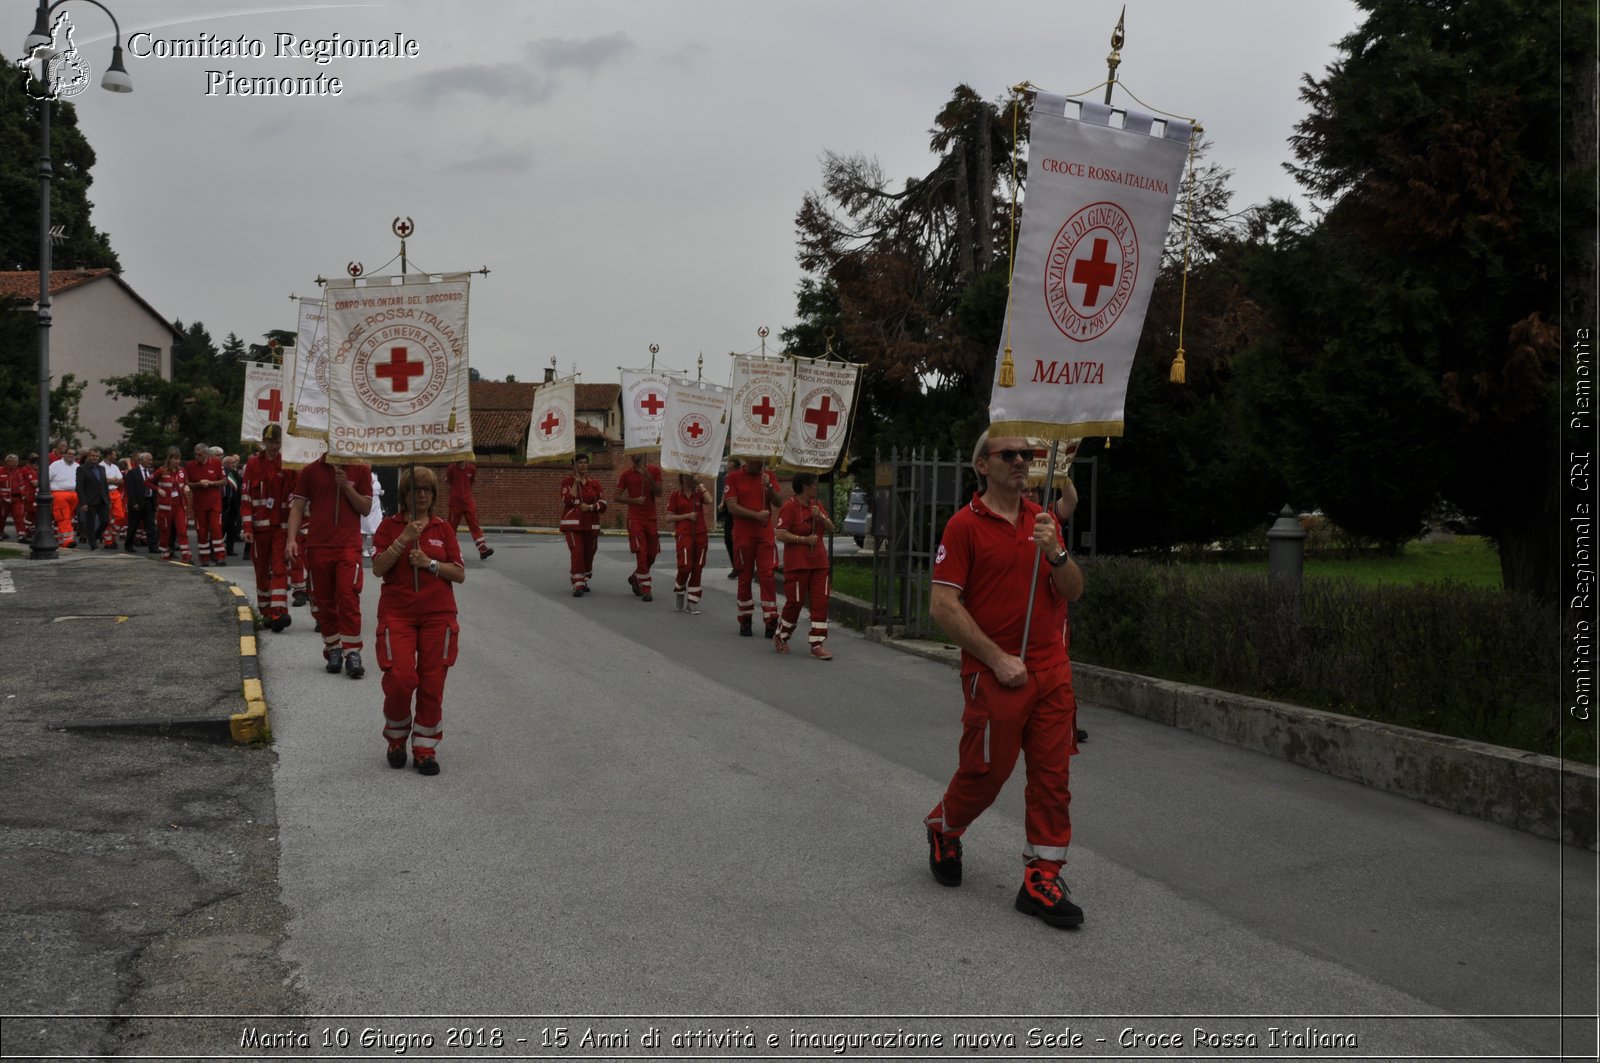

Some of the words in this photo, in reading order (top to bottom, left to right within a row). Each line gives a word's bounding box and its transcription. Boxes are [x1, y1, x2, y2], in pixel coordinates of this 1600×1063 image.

[1042, 158, 1085, 177] CROCE
[1088, 166, 1123, 184] ROSSA
[1124, 173, 1169, 194] ITALIANA
[1071, 216, 1087, 236] DI
[1088, 208, 1128, 240] GINEVRA
[1123, 240, 1135, 258] 22
[1050, 231, 1081, 334] CONVENZIONE
[1108, 260, 1135, 316] AGOSTO
[335, 300, 359, 310] CORPO
[362, 297, 404, 307] VOLONTARI
[408, 295, 422, 305] DEL
[425, 293, 462, 304] SOCCORSO
[1089, 312, 1109, 335] 1864
[334, 323, 365, 365] CROCE
[366, 308, 415, 326] ROSSA
[417, 311, 462, 359] ITALIANA
[369, 336, 378, 348] DI
[382, 327, 429, 344] GINEVRA
[354, 351, 390, 412] CONVENZIONE
[1032, 360, 1104, 385] MANTA
[335, 426, 397, 438] GRUPPO
[402, 424, 416, 436] DI
[421, 422, 466, 435] MELE
[335, 440, 405, 453] COMITATO
[412, 438, 464, 451] LOCALE
